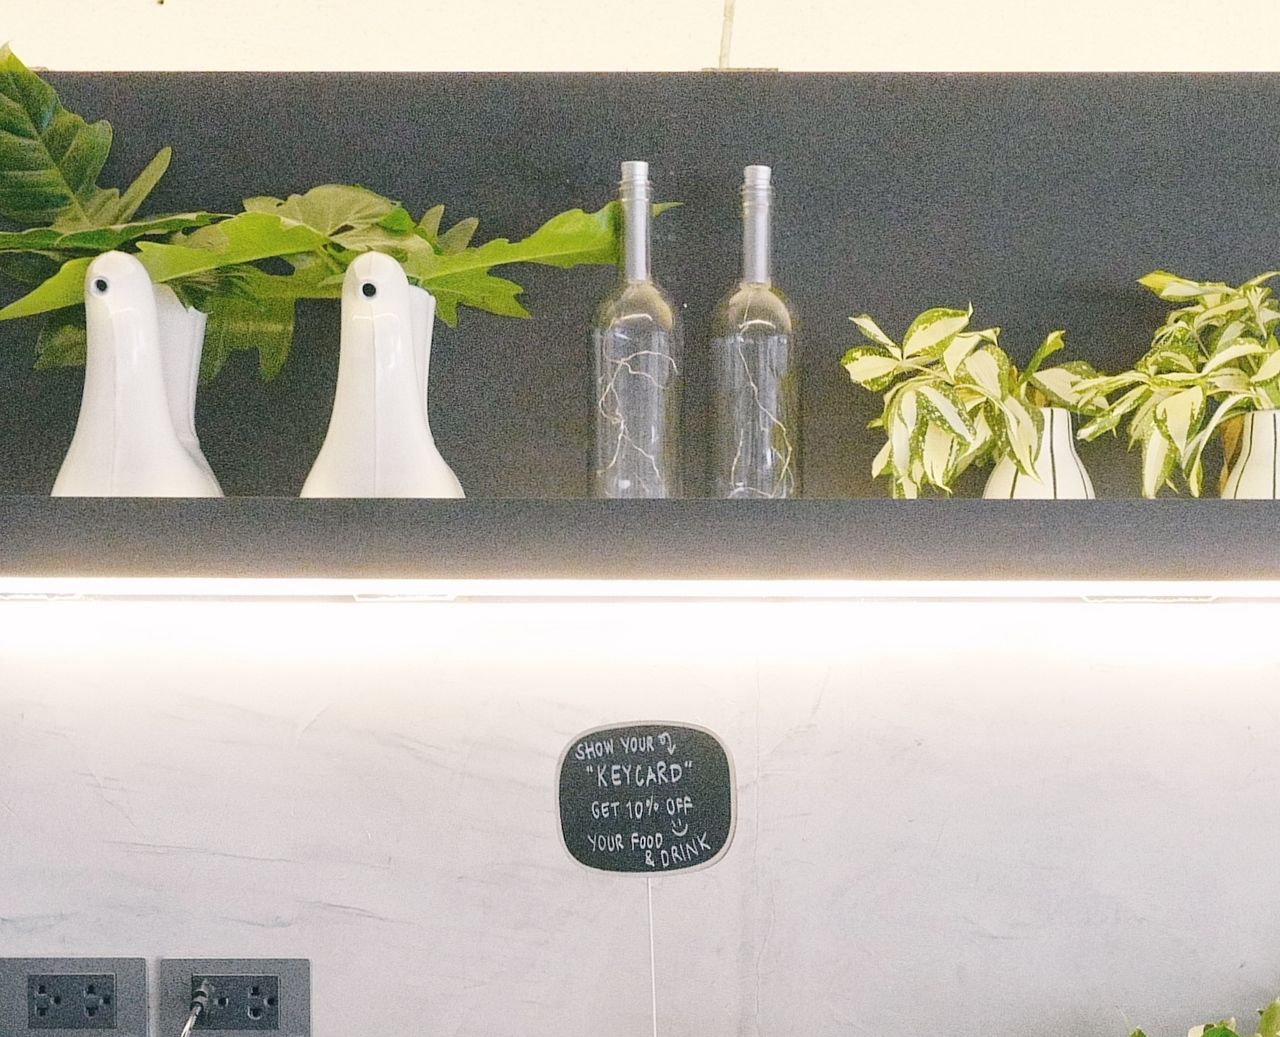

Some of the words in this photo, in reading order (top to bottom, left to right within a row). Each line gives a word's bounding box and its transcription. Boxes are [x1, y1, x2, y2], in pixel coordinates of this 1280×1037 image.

[575, 738, 614, 760] SHOW
[620, 735, 655, 753] YOUR
[586, 761, 692, 787] "KEYCARD"
[591, 801, 620, 819] GET
[627, 795, 659, 819] 10%
[666, 796, 693, 815] OFF
[588, 833, 624, 851] YOUR
[631, 832, 663, 850] FOOD
[645, 849, 655, 867] &
[661, 832, 711, 868] DRINK
